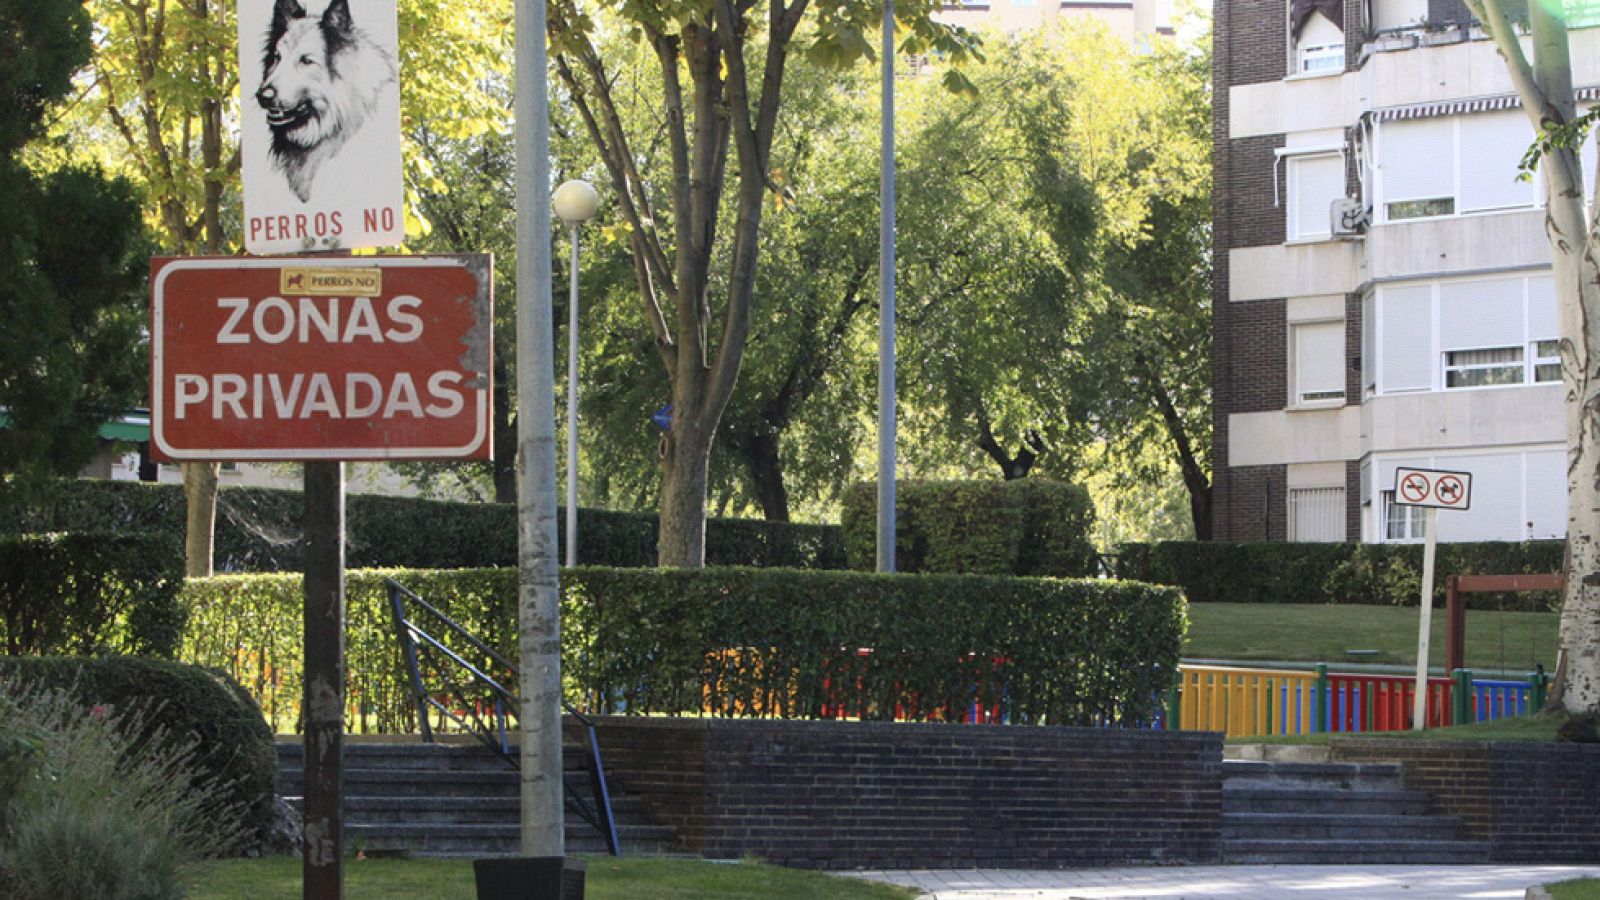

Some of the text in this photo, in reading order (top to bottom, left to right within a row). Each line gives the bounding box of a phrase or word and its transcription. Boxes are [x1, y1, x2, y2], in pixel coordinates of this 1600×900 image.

[250, 207, 394, 241] PERROS NO
[311, 276, 374, 287] PERROS NO
[216, 295, 424, 344] ZONAS
[174, 370, 465, 420] PRIVADAS
